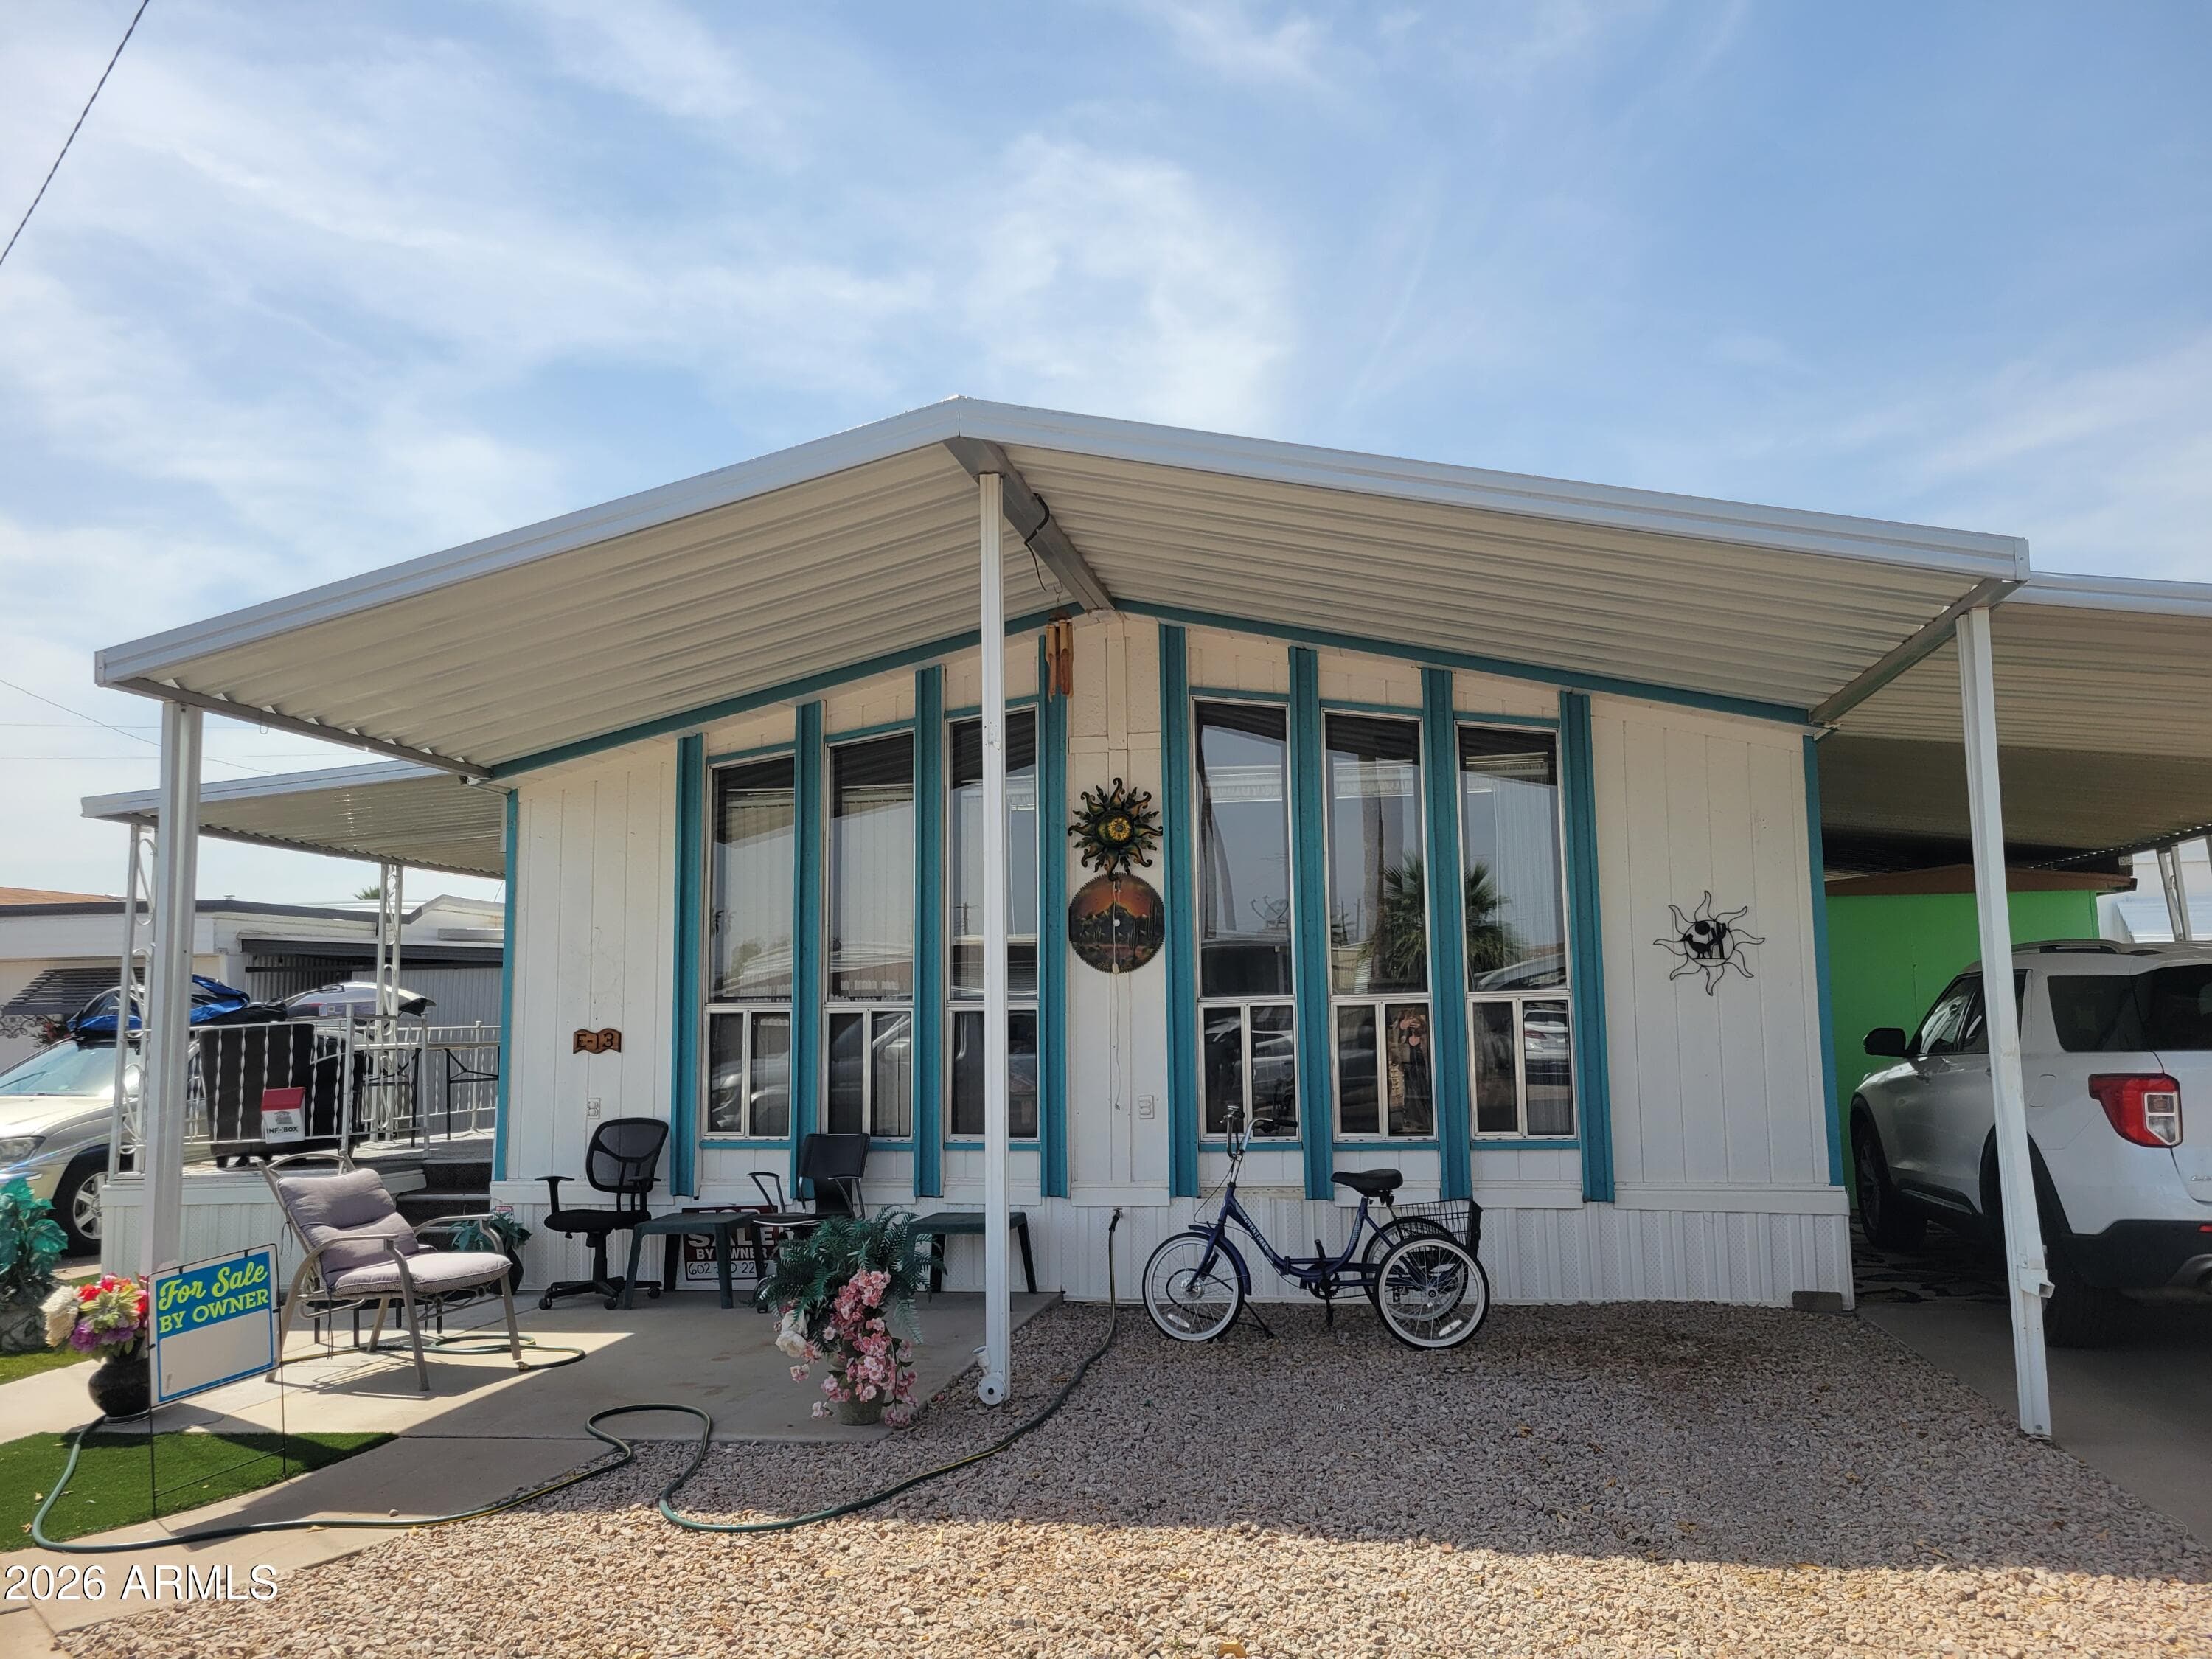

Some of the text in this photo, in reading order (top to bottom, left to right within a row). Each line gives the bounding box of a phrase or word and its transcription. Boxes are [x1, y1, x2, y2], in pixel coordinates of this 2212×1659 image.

[577, 1033, 614, 1049] E-13
[688, 1227, 775, 1248] SLE
[1242, 1216, 1269, 1251] ADVENTURER
[695, 1247, 768, 1260] BY WNER
[158, 1262, 268, 1311] For Sale
[159, 1289, 269, 1333] BY OWNER
